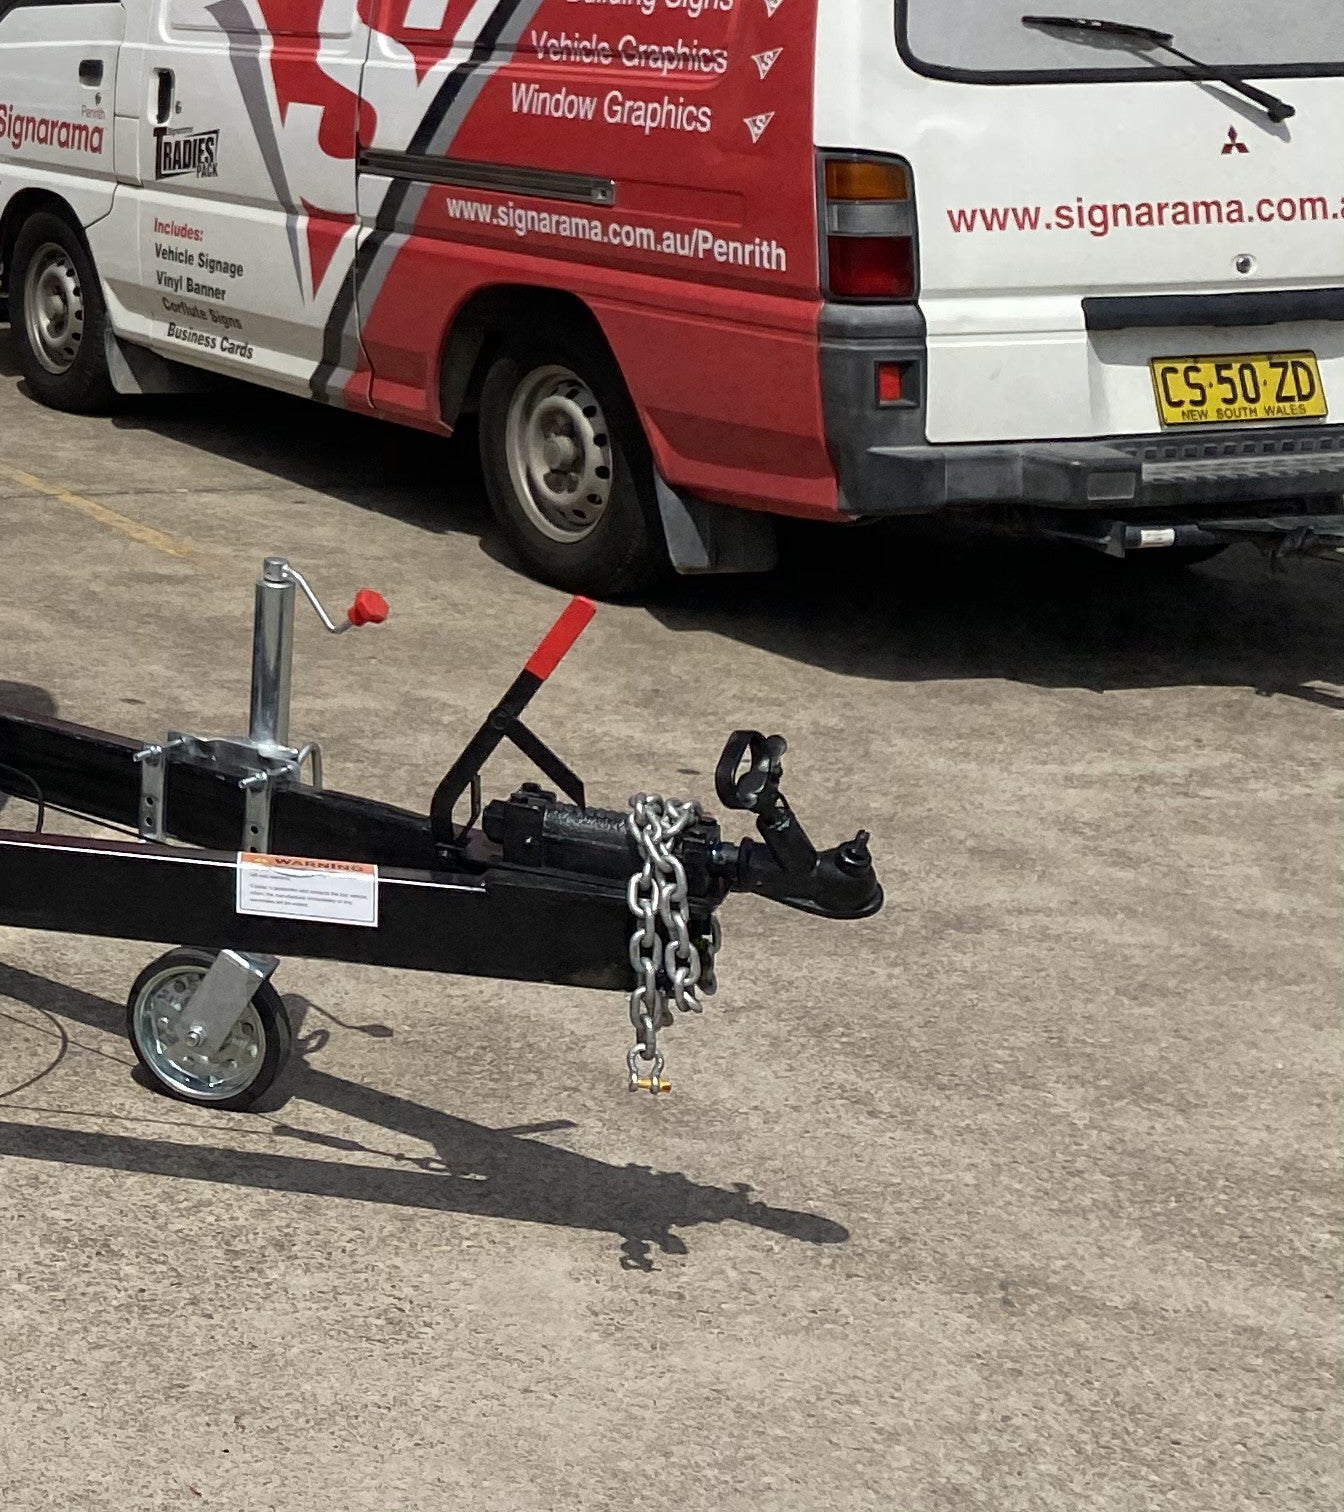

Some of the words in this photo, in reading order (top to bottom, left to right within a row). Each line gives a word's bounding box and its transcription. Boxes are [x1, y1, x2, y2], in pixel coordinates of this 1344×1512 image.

[531, 29, 611, 67] Vehicle
[618, 33, 729, 76] Graphics
[511, 82, 596, 122] Window
[602, 90, 712, 136] Graphics
[153, 126, 215, 181] TRADIES
[196, 162, 219, 179] PACK
[154, 217, 204, 242] Includes:
[446, 195, 787, 272] www.signarama.com.au/Penrith
[947, 196, 1344, 238] www.signarama.com.
[155, 242, 195, 266] Vehicle
[197, 251, 244, 279] Signage
[156, 269, 183, 293] Vinyl
[186, 276, 227, 301] Banner
[162, 296, 209, 321] Corflute
[209, 308, 243, 330] Signs
[167, 321, 217, 349] Business
[220, 336, 254, 359] Cards
[1181, 408, 1209, 421] NEW
[1216, 406, 1258, 420] SOUTH
[1264, 404, 1307, 417] WALES
[275, 857, 364, 872] WARNING
